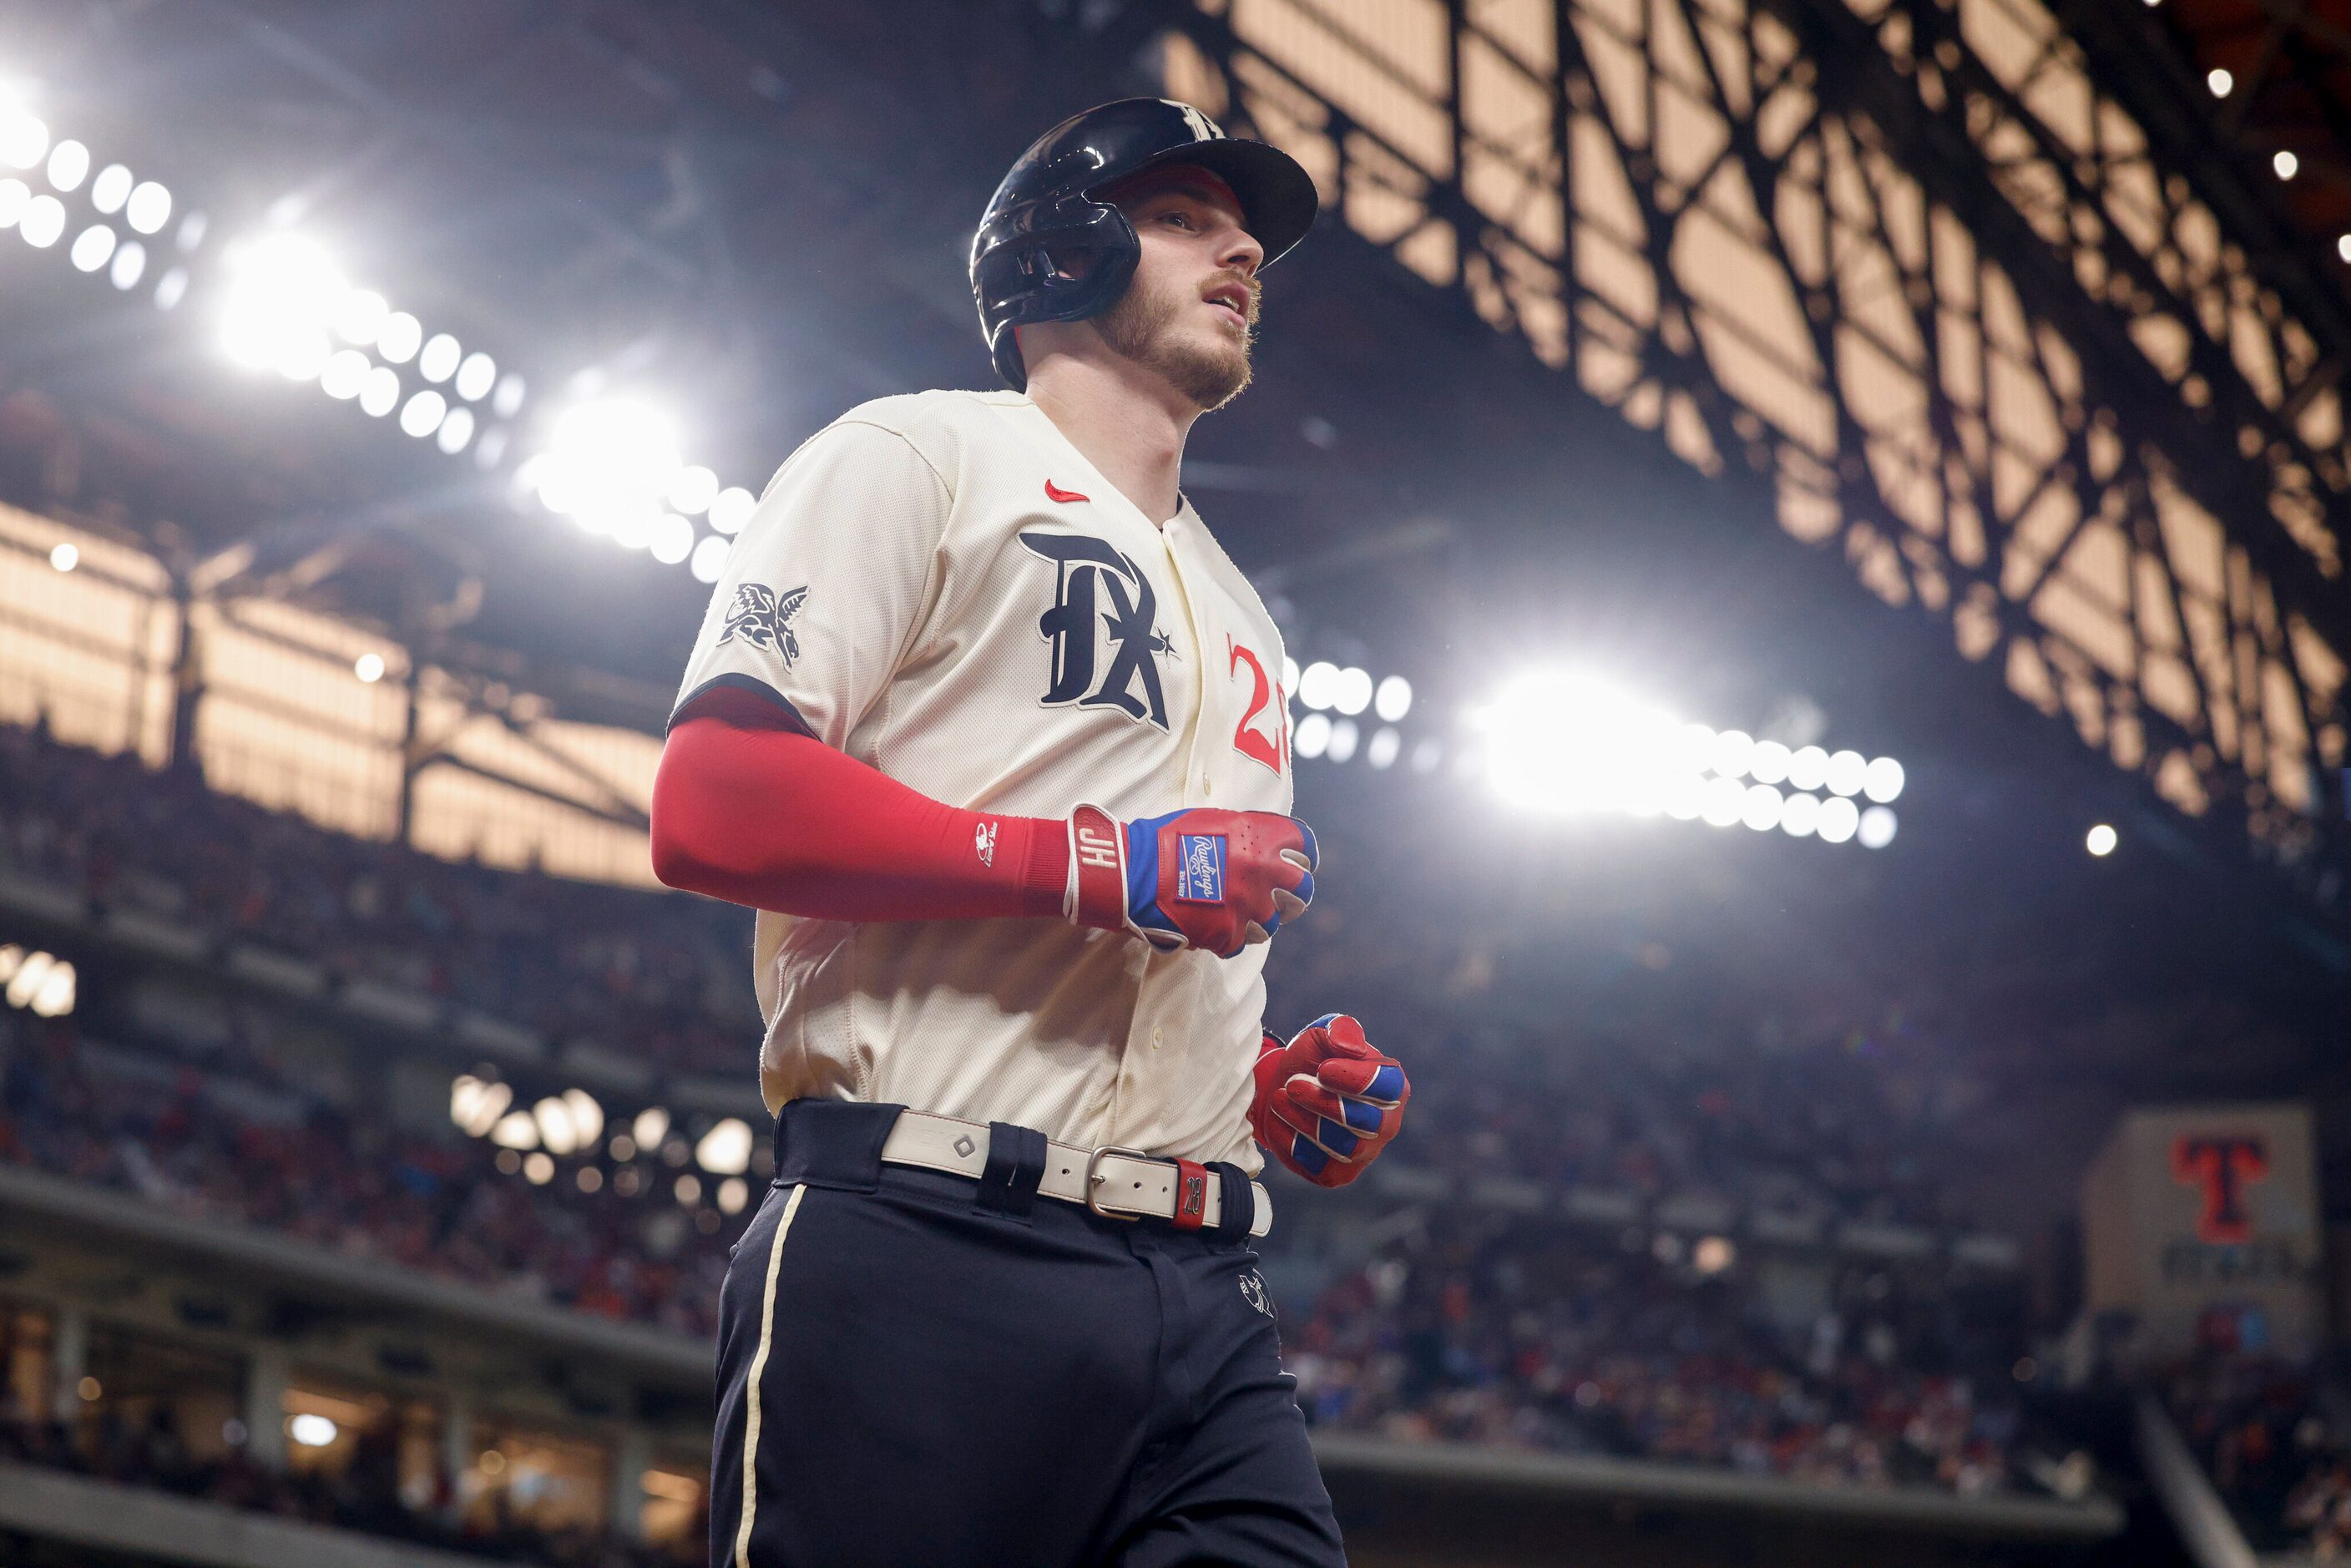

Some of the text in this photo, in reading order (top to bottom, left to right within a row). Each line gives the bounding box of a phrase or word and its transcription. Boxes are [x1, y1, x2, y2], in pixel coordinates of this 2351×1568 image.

[1226, 631, 1290, 777] 2
[1079, 827, 1117, 869] JH
[1193, 836, 1216, 898] Rawlings
[1184, 1176, 1204, 1216] 28
